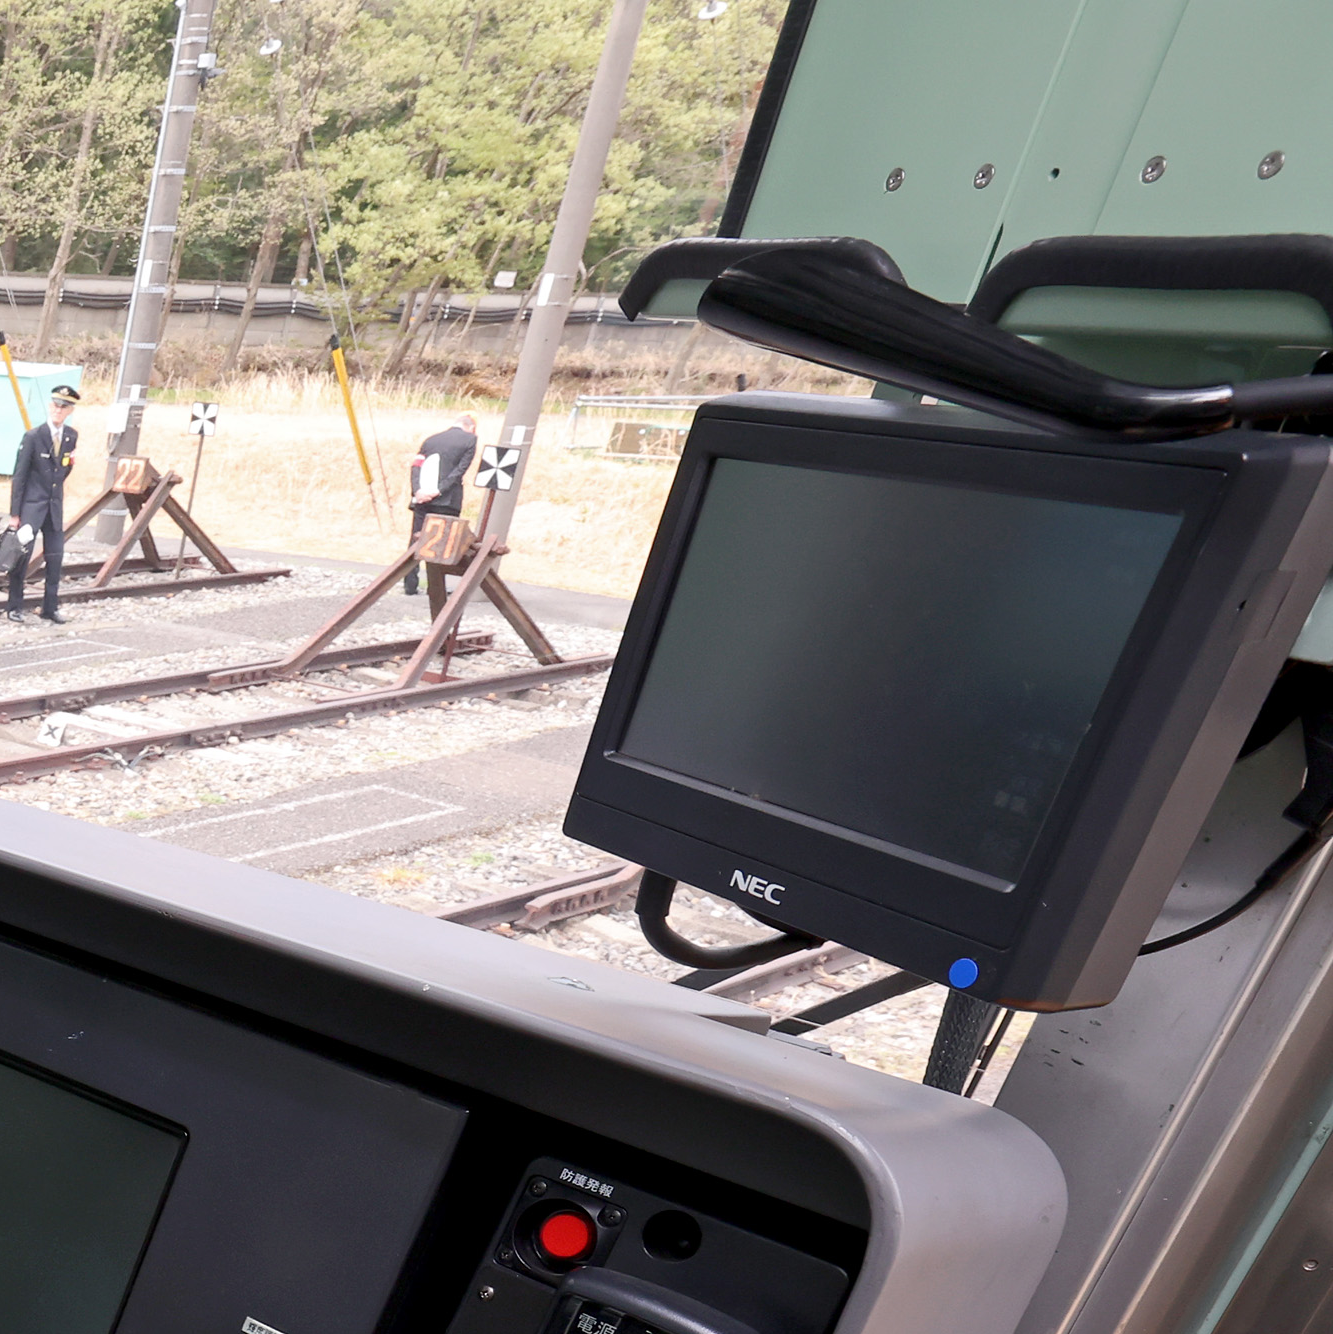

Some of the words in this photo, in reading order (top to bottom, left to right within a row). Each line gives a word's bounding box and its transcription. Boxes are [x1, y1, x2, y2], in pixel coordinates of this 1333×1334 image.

[113, 458, 145, 491] 22
[420, 518, 459, 559] 21
[730, 869, 785, 906] NEC
[559, 1167, 615, 1199] 防護発報
